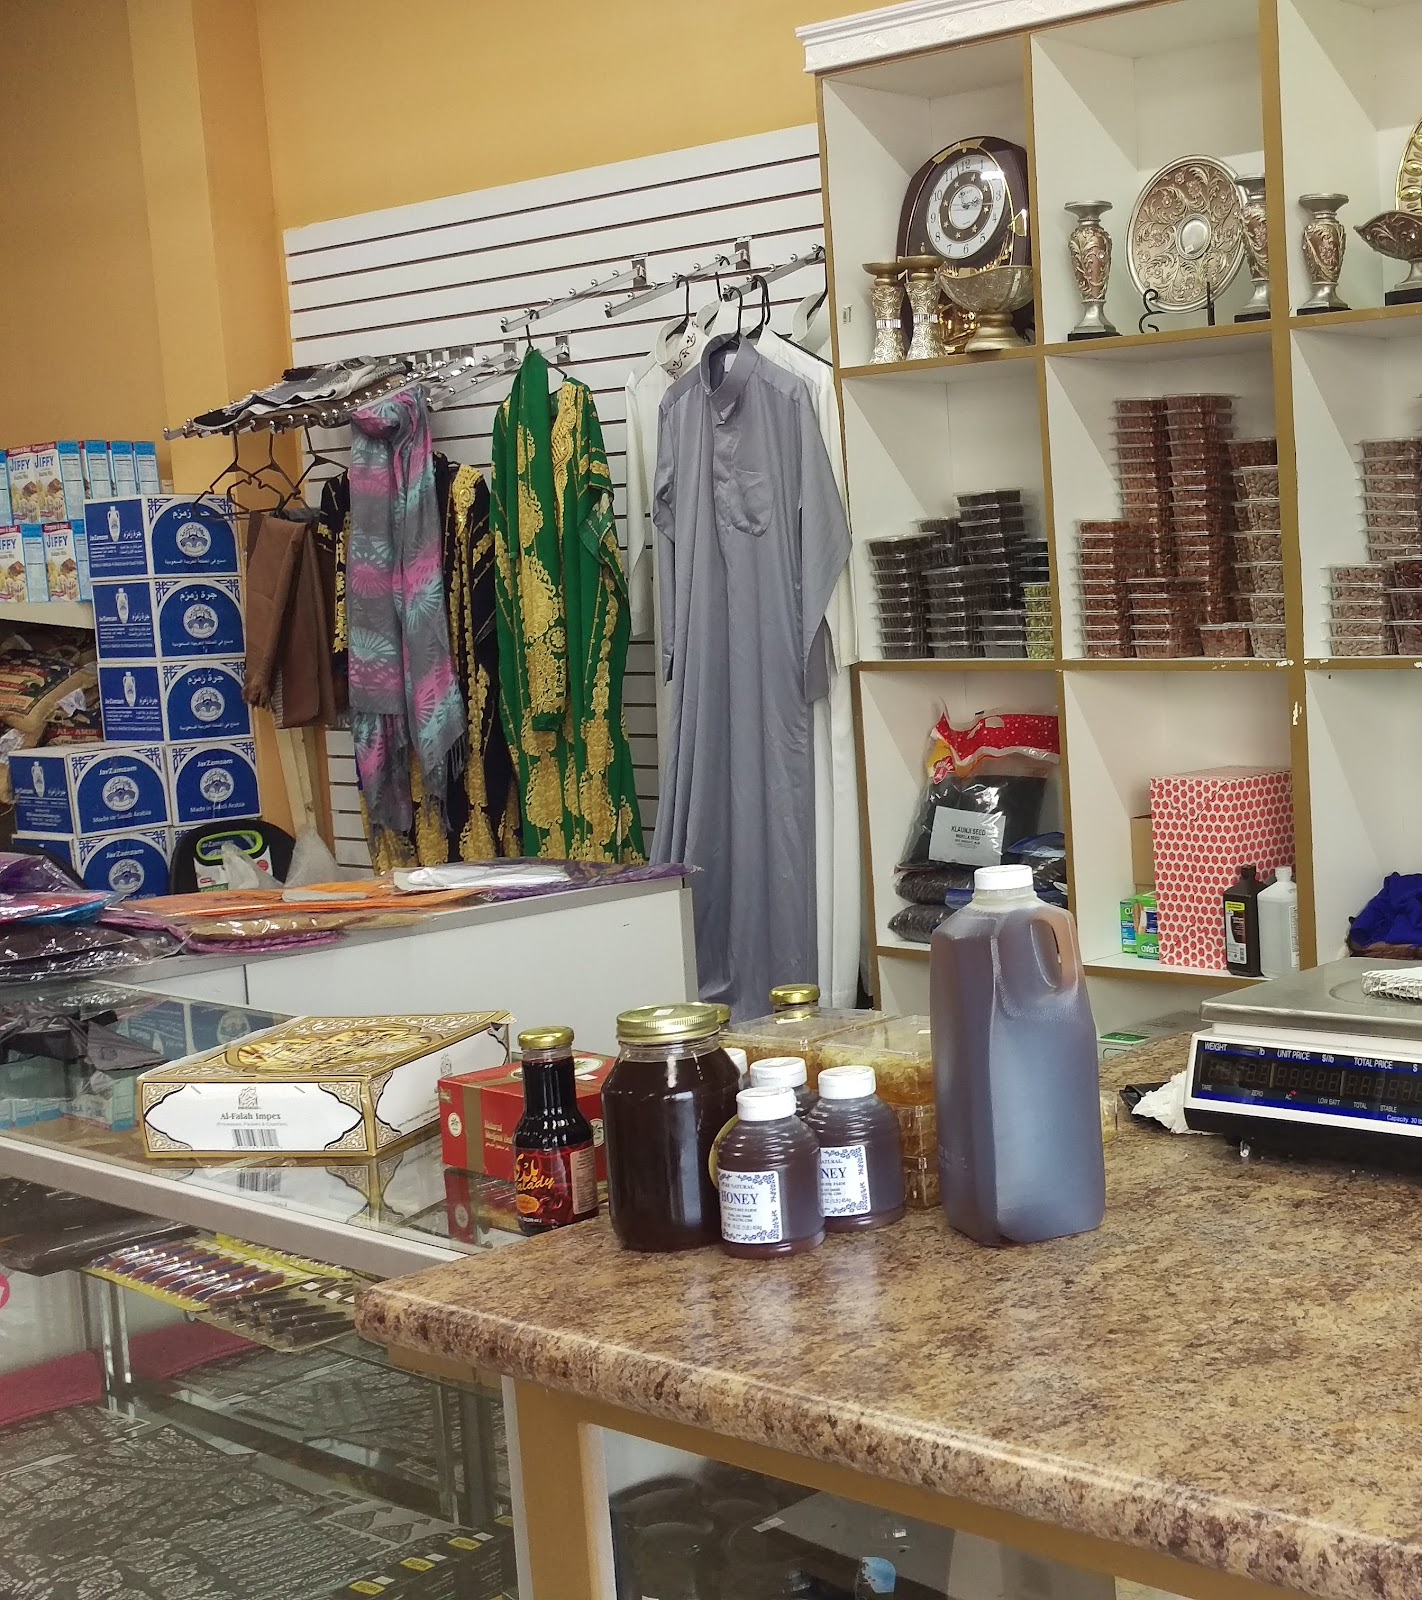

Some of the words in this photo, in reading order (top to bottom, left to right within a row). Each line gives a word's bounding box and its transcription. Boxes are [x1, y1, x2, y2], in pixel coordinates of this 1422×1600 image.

[961, 159, 971, 171] 12
[945, 171, 953, 182] 11
[934, 190, 942, 201] 10
[930, 213, 936, 223] 9
[935, 232, 941, 243] 8
[947, 244, 952, 254] 7
[963, 244, 969, 254] 6
[10, 458, 30, 472] JIFFY
[34, 455, 54, 468] JIFFY
[0, 538, 16, 550] IFFY
[46, 534, 68, 547] JIFFY
[196, 758, 233, 768] JarZamzam
[99, 765, 138, 775] JarZamzam
[972, 828, 986, 836] SEED
[106, 849, 144, 859] JarZamzam
[1204, 1042, 1228, 1052] WEIGHT
[1277, 1049, 1291, 1058] UNIT
[1292, 1051, 1311, 1061] PRICE
[1321, 1054, 1335, 1064] $/lb
[1353, 1056, 1373, 1067] TOTAL
[1373, 1059, 1394, 1070] PRICE
[1412, 1063, 1418, 1073] $
[1251, 1089, 1264, 1098] ZERO
[1317, 1097, 1328, 1105] LOW
[1328, 1098, 1341, 1106] BATT
[1353, 1101, 1368, 1110] TOTAL
[1379, 1104, 1397, 1113] STABLE
[220, 1112, 253, 1120] Al-Falah
[256, 1113, 281, 1121] Impex
[820, 1166, 847, 1179] NEY
[517, 1176, 554, 1190] alady
[721, 1190, 759, 1205] HONEY
